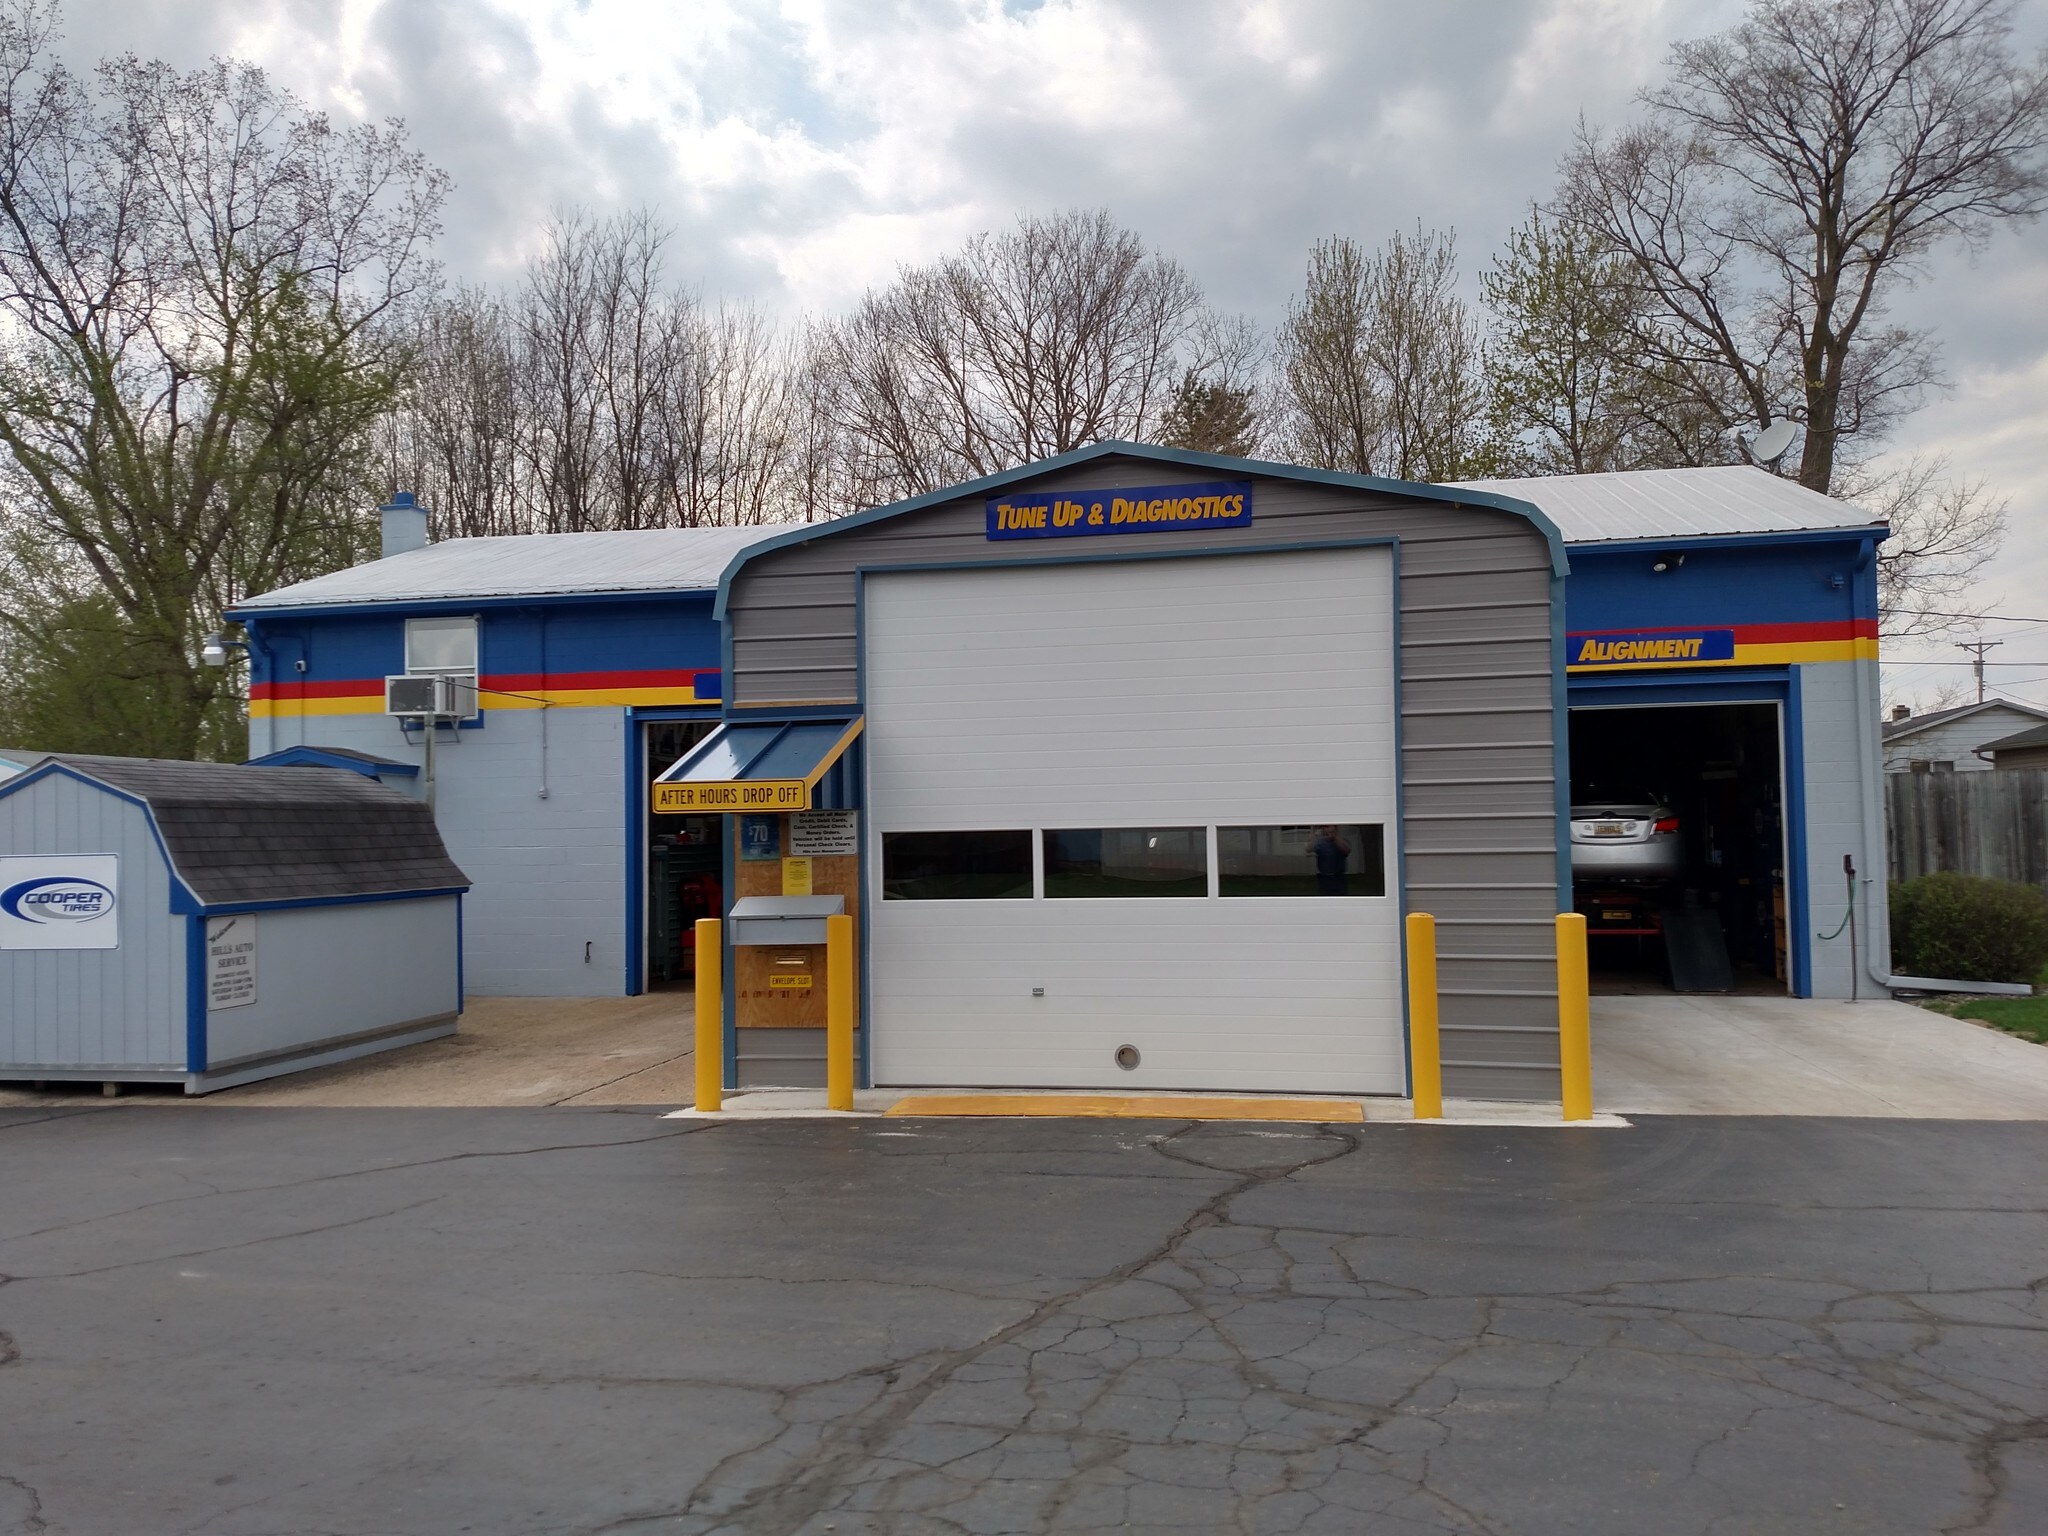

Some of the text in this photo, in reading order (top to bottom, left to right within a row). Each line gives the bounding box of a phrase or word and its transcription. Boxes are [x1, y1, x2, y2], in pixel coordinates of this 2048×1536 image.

[1052, 500, 1084, 527] UP
[1087, 503, 1104, 525] &
[1110, 494, 1244, 524] DIAGNOSTICS
[1578, 638, 1703, 661] ALIGNMENT
[660, 786, 800, 805] AFTER HOURS DROP OFF
[748, 824, 769, 843] $70
[24, 892, 103, 904] COOPER
[63, 904, 100, 912] TIRES
[234, 942, 254, 953] AUTO
[218, 956, 248, 968] SERVICE
[772, 977, 810, 985] ENVELOPE SLOT
